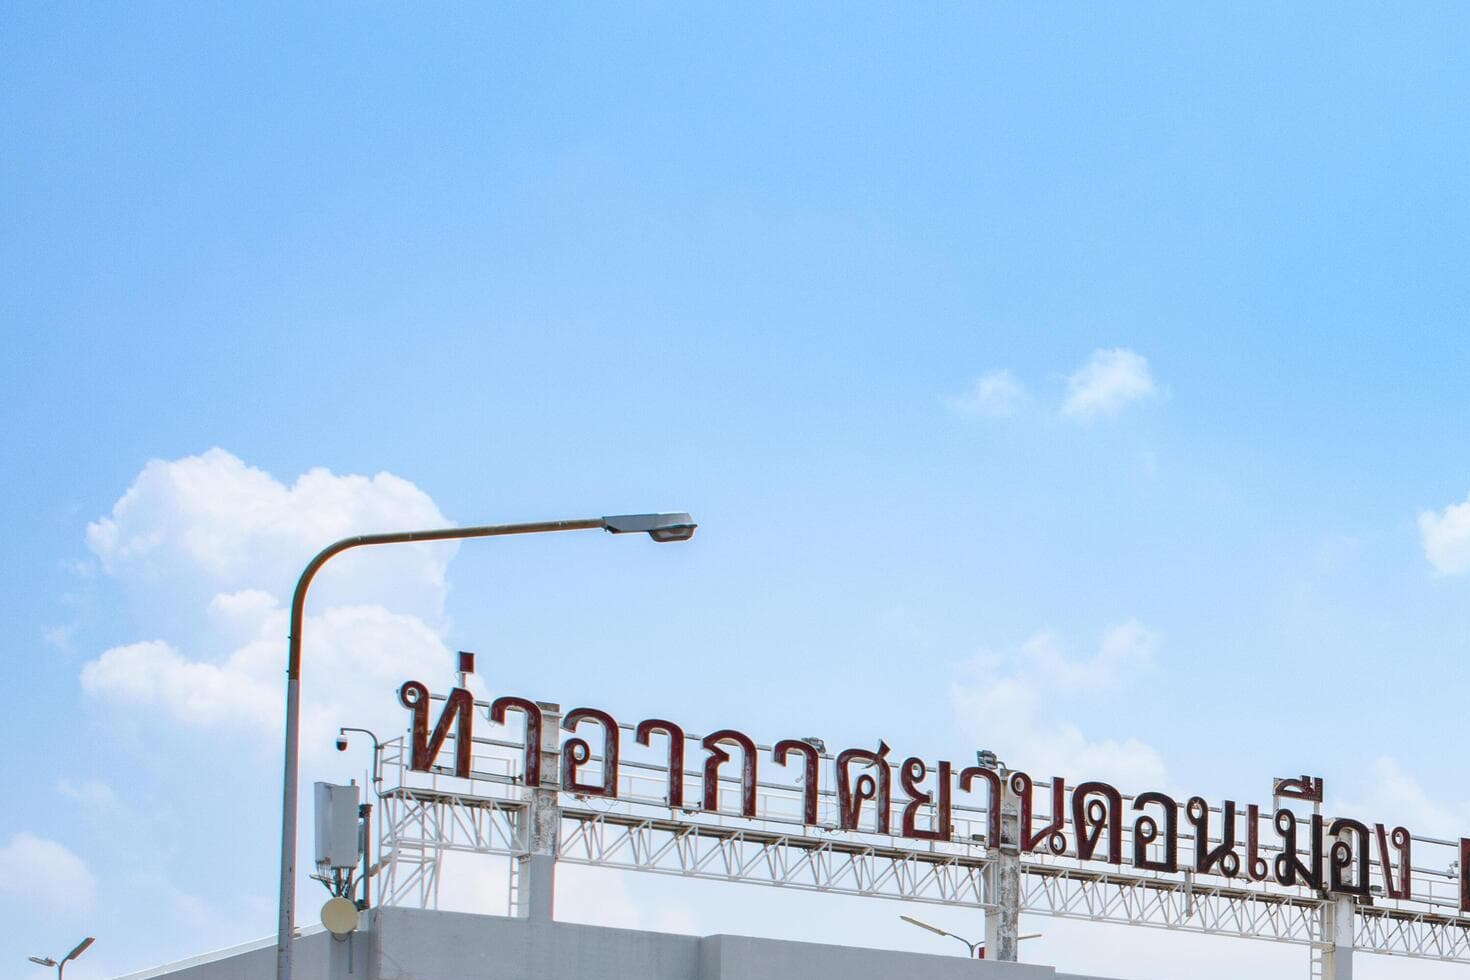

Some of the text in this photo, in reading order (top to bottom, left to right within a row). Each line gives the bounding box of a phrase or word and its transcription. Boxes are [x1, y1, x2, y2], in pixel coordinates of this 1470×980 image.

[399, 651, 1411, 900] ท่าอากาศยานดอนเมือง
